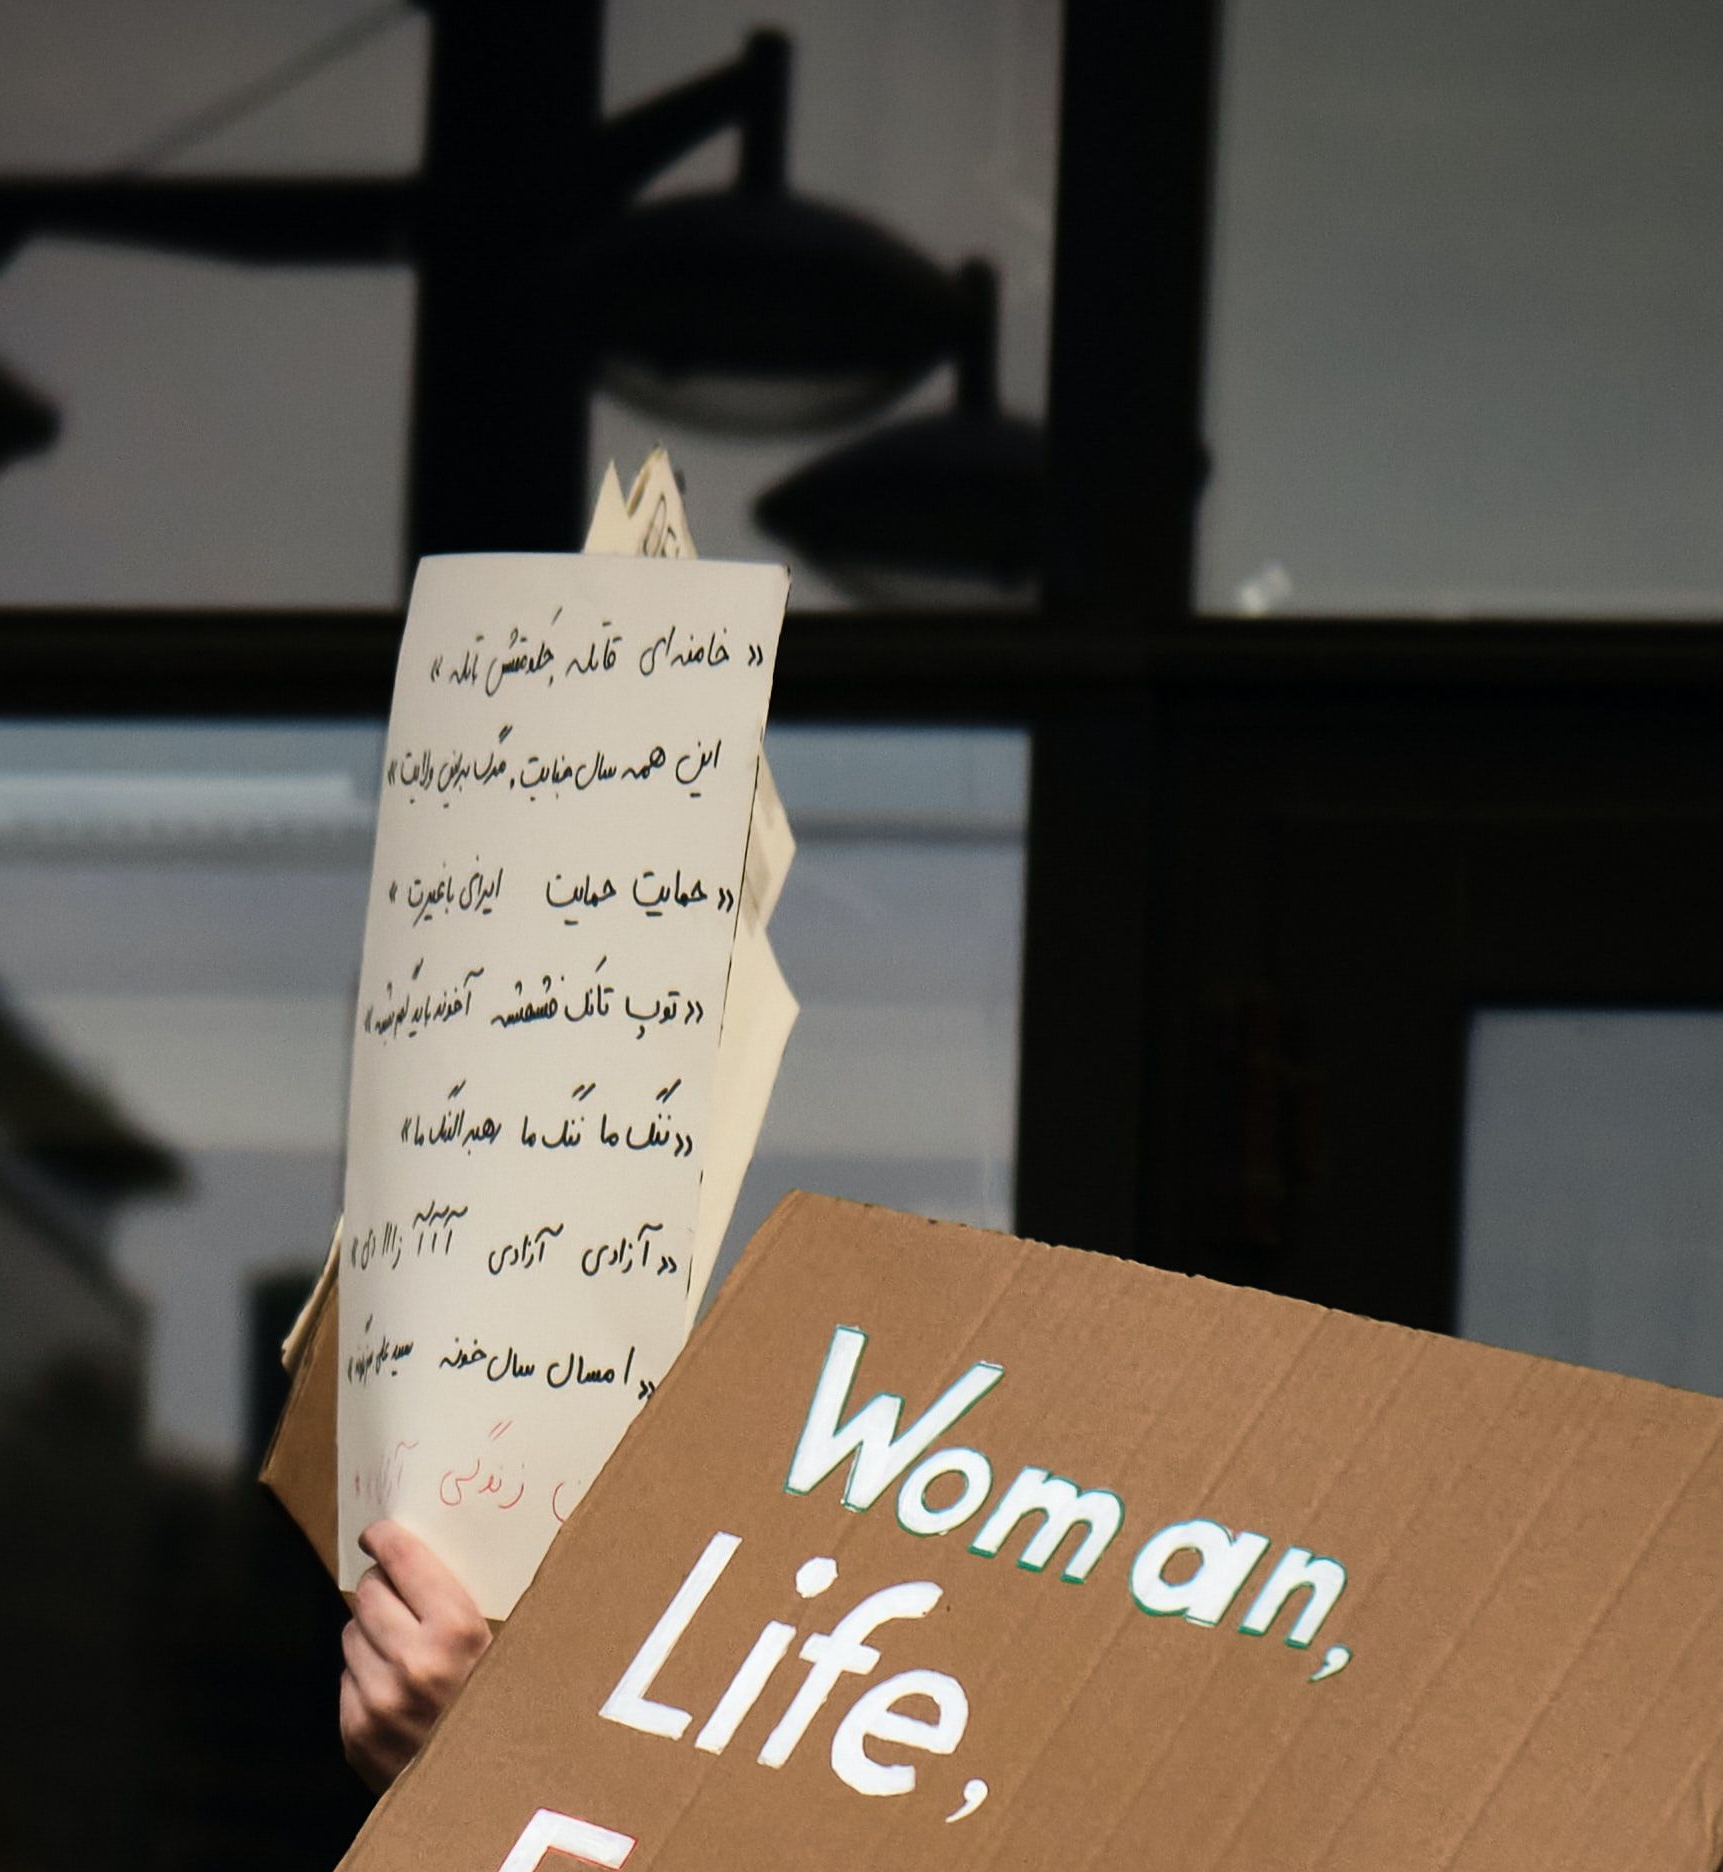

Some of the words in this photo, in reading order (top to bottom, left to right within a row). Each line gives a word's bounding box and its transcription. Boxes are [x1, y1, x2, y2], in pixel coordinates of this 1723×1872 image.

[473, 724, 514, 786] مرگ
[574, 751, 618, 791] سال
[620, 745, 667, 781] همه
[676, 738, 722, 798] این
[545, 874, 617, 927] حمایت
[564, 954, 615, 1022] تانک
[520, 1114, 537, 1148] ما
[541, 1082, 597, 1150] ننگ
[599, 1113, 620, 1148] ما
[487, 1222, 565, 1276] آزادی
[437, 1338, 488, 1370] خونه
[486, 1346, 536, 1383] سال
[439, 1419, 526, 1510] زندگی
[782, 1322, 1353, 1685] Woman,
[597, 1531, 991, 1824] Life,
